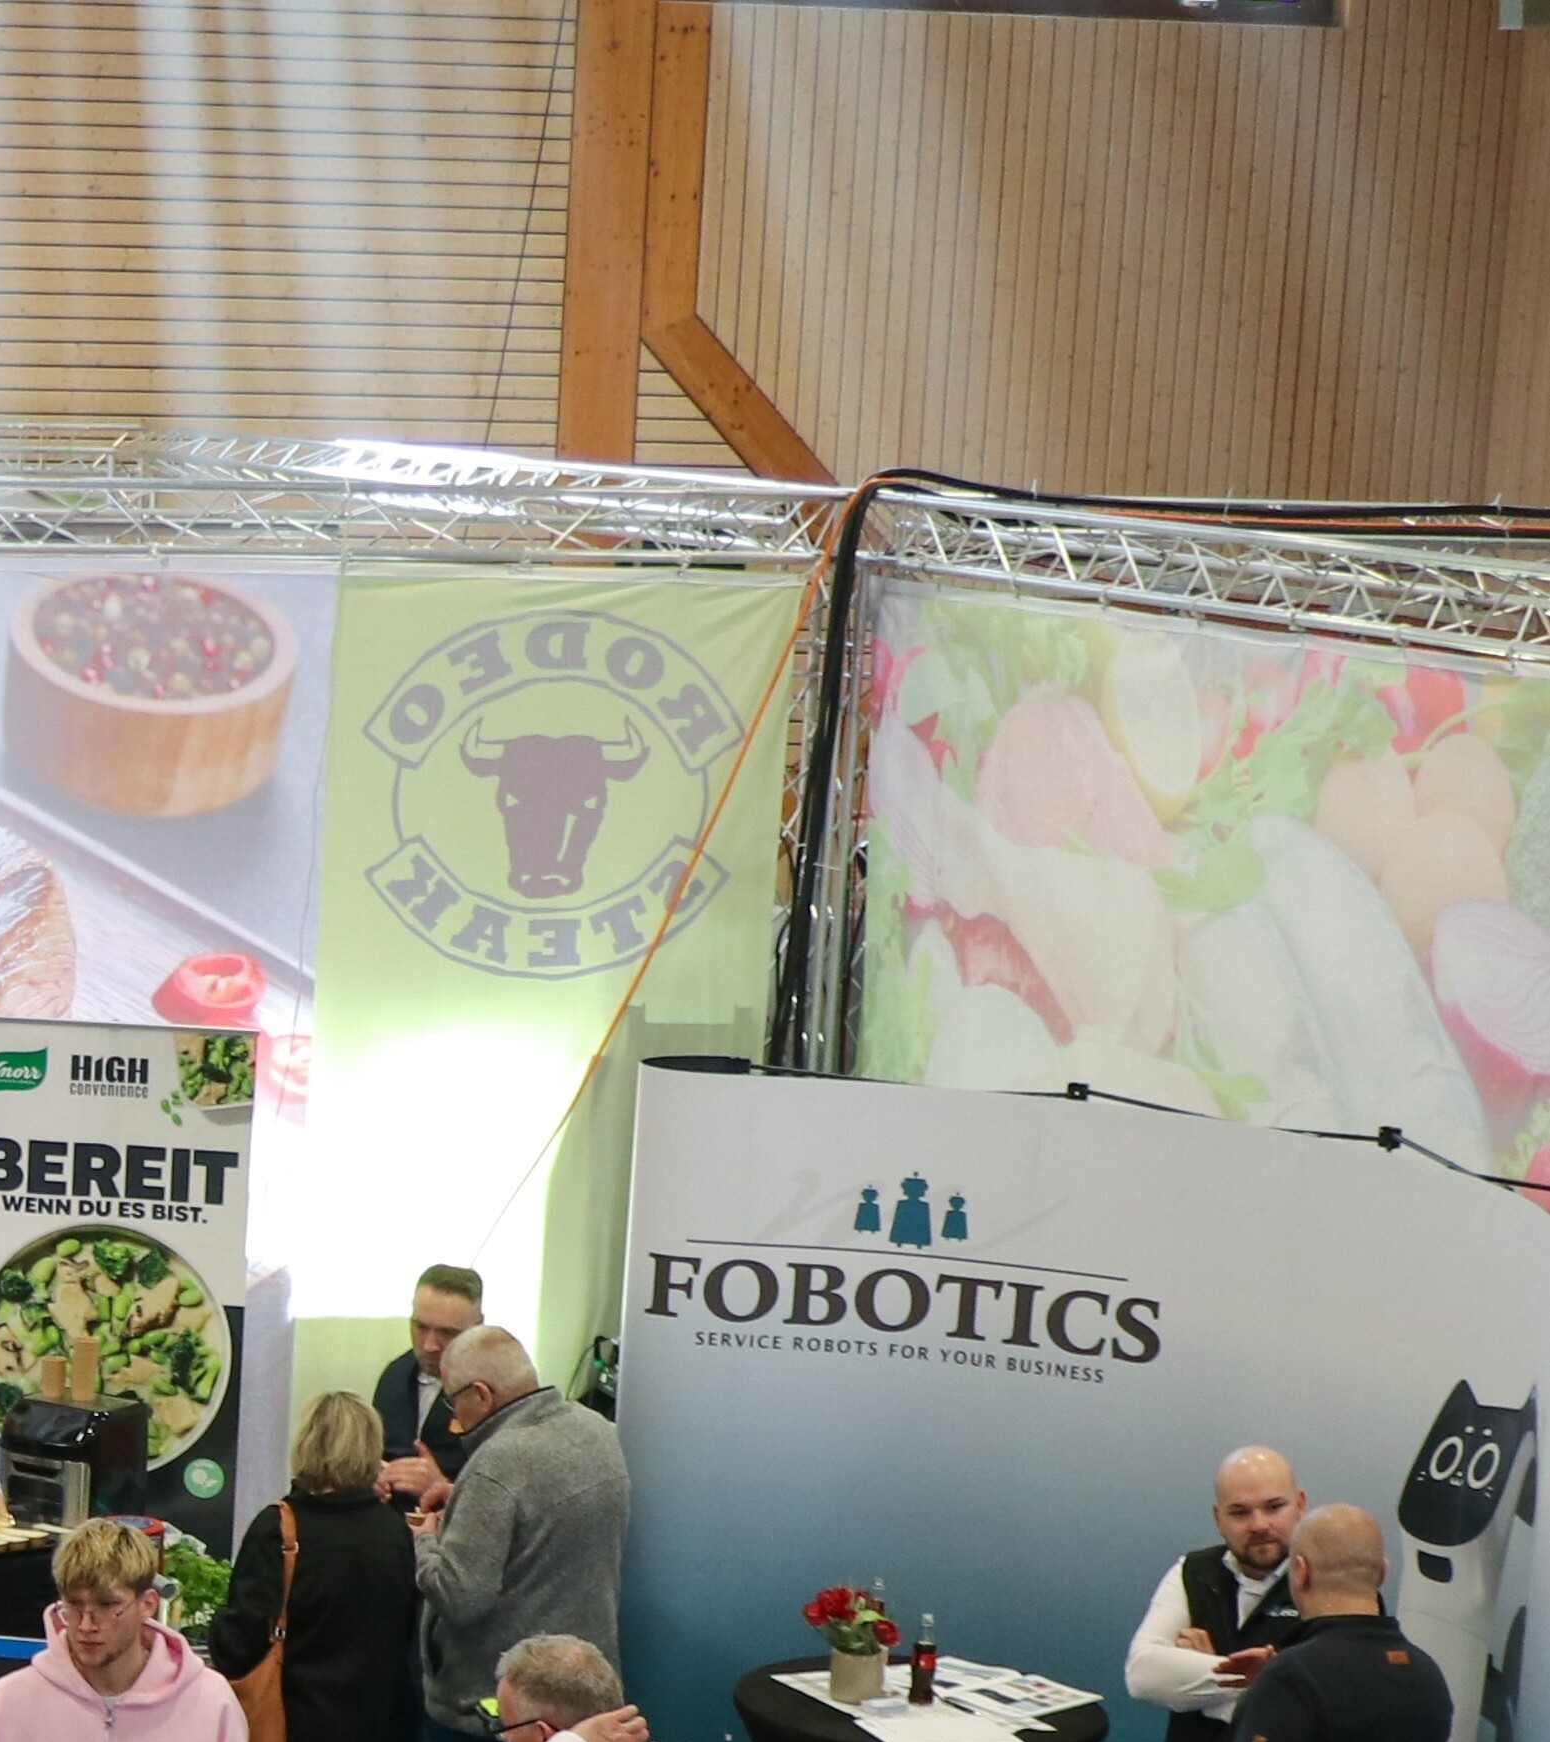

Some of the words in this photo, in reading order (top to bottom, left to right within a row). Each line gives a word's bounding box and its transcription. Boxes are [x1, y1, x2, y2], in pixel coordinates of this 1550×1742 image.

[70, 1054, 149, 1085] HIGH
[2, 1194, 72, 1216] WENN
[78, 1199, 111, 1217] DU
[118, 1202, 146, 1220] ES
[151, 1204, 208, 1225] BIST.
[643, 1251, 1162, 1365] FOBOTICS
[693, 1330, 783, 1351] SERVICE
[792, 1336, 879, 1357] ROBOTS
[887, 1343, 930, 1362] FOR
[940, 1348, 997, 1370] YOUR
[1005, 1356, 1106, 1384] BUSINESS
